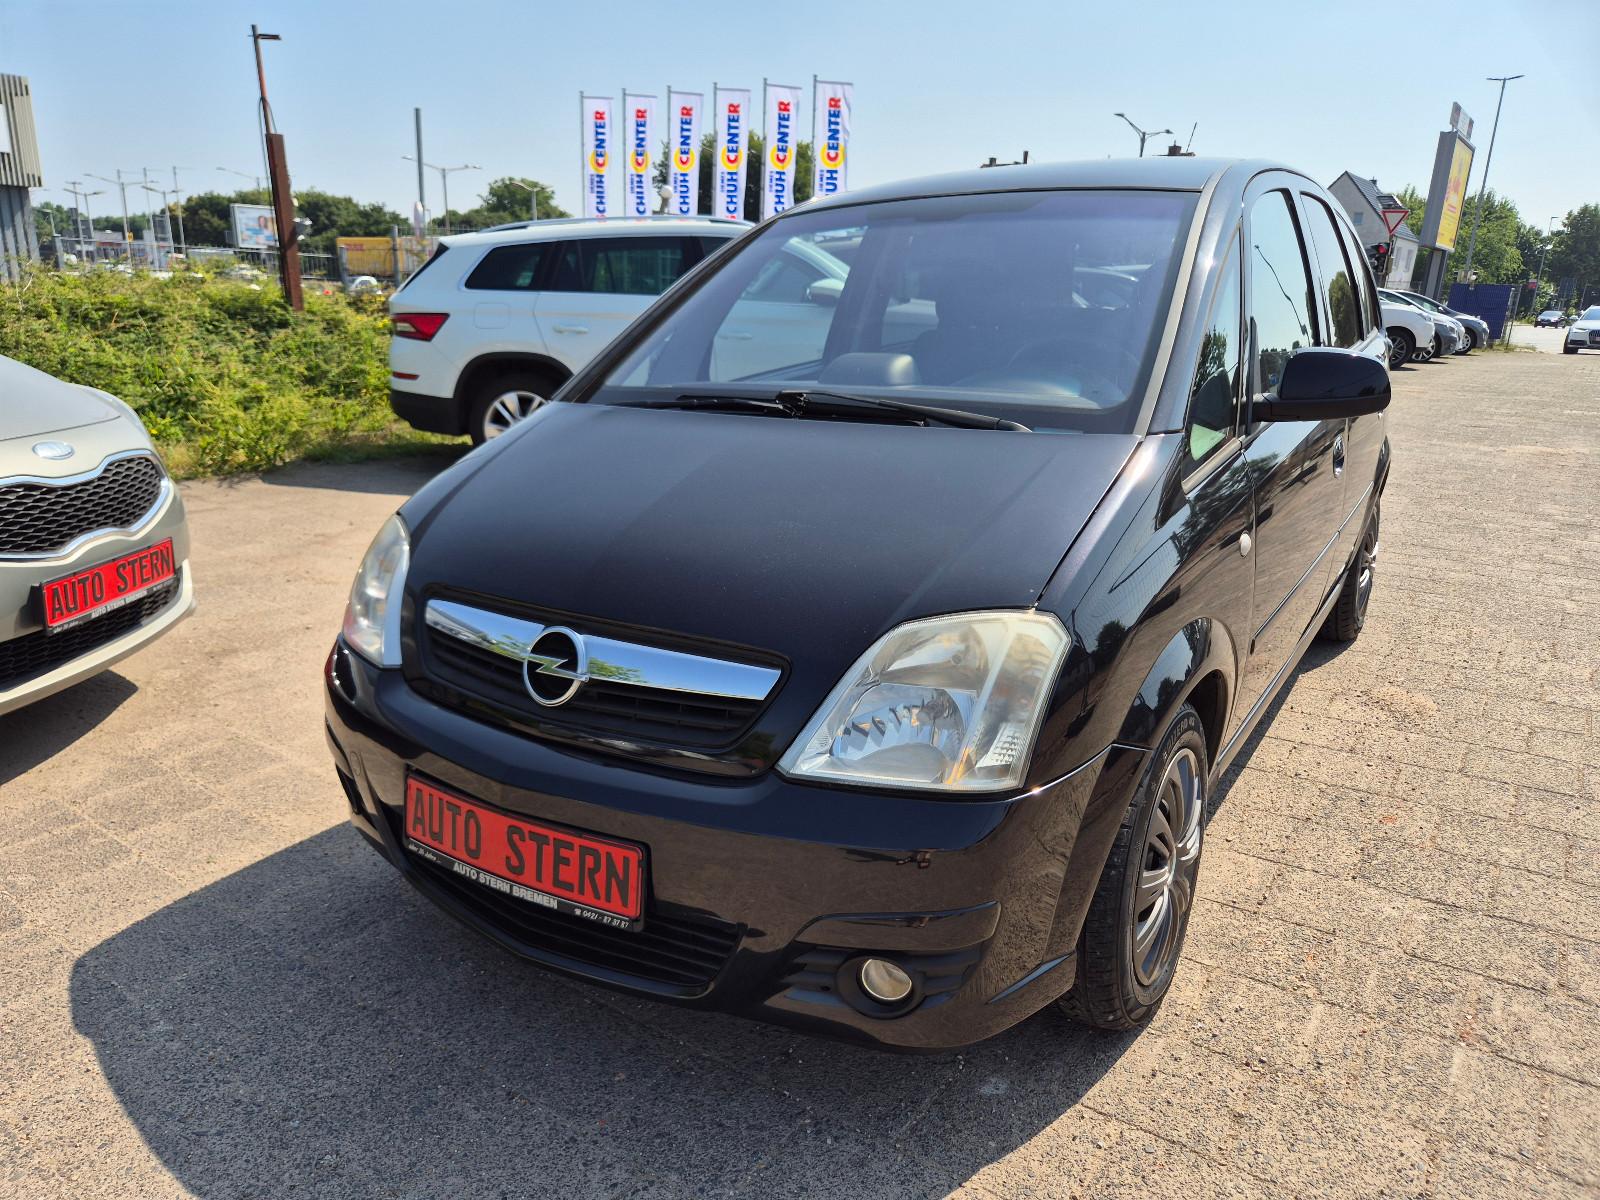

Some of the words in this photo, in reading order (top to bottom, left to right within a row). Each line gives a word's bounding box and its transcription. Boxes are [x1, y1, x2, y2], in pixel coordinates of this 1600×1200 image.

[594, 110, 606, 167] CENTER
[635, 108, 647, 166] CENTER
[680, 106, 693, 165] CENTER
[727, 103, 741, 163] CENTER
[776, 101, 791, 163] CENTER
[827, 97, 841, 162] CENTER
[52, 572, 104, 620] AUTO
[116, 546, 171, 593] STERN
[412, 788, 482, 859] AUTO
[505, 824, 630, 908] STERN
[453, 862, 478, 880] AUTO
[479, 873, 510, 893] STERN
[512, 886, 558, 909] BREMEN
